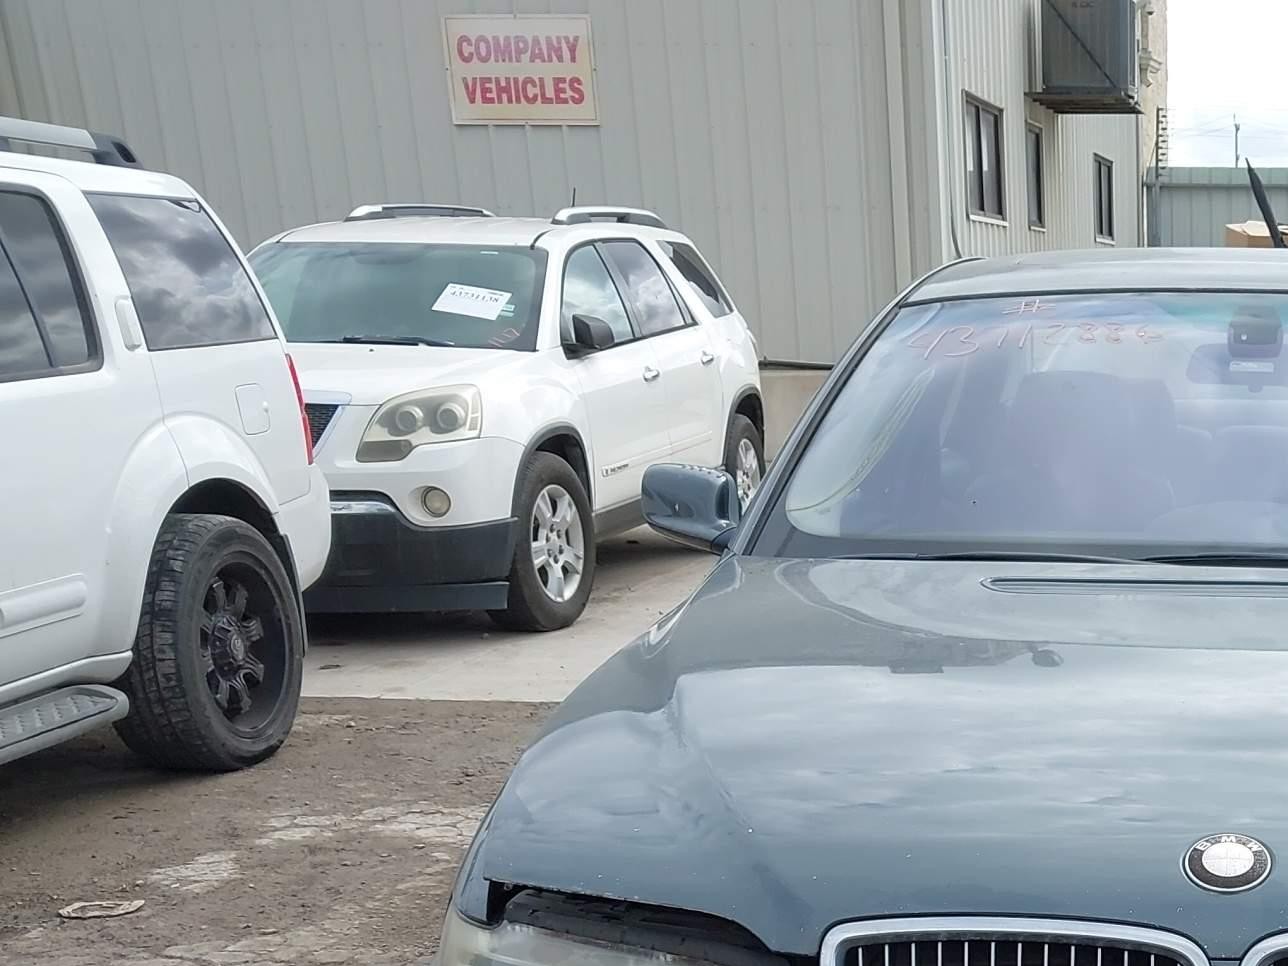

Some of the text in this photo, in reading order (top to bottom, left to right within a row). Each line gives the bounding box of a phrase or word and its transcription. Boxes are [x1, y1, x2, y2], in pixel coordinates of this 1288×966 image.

[456, 34, 580, 64] COMPANY
[462, 76, 586, 105] VEHICLES
[1194, 835, 1264, 852] BMW
